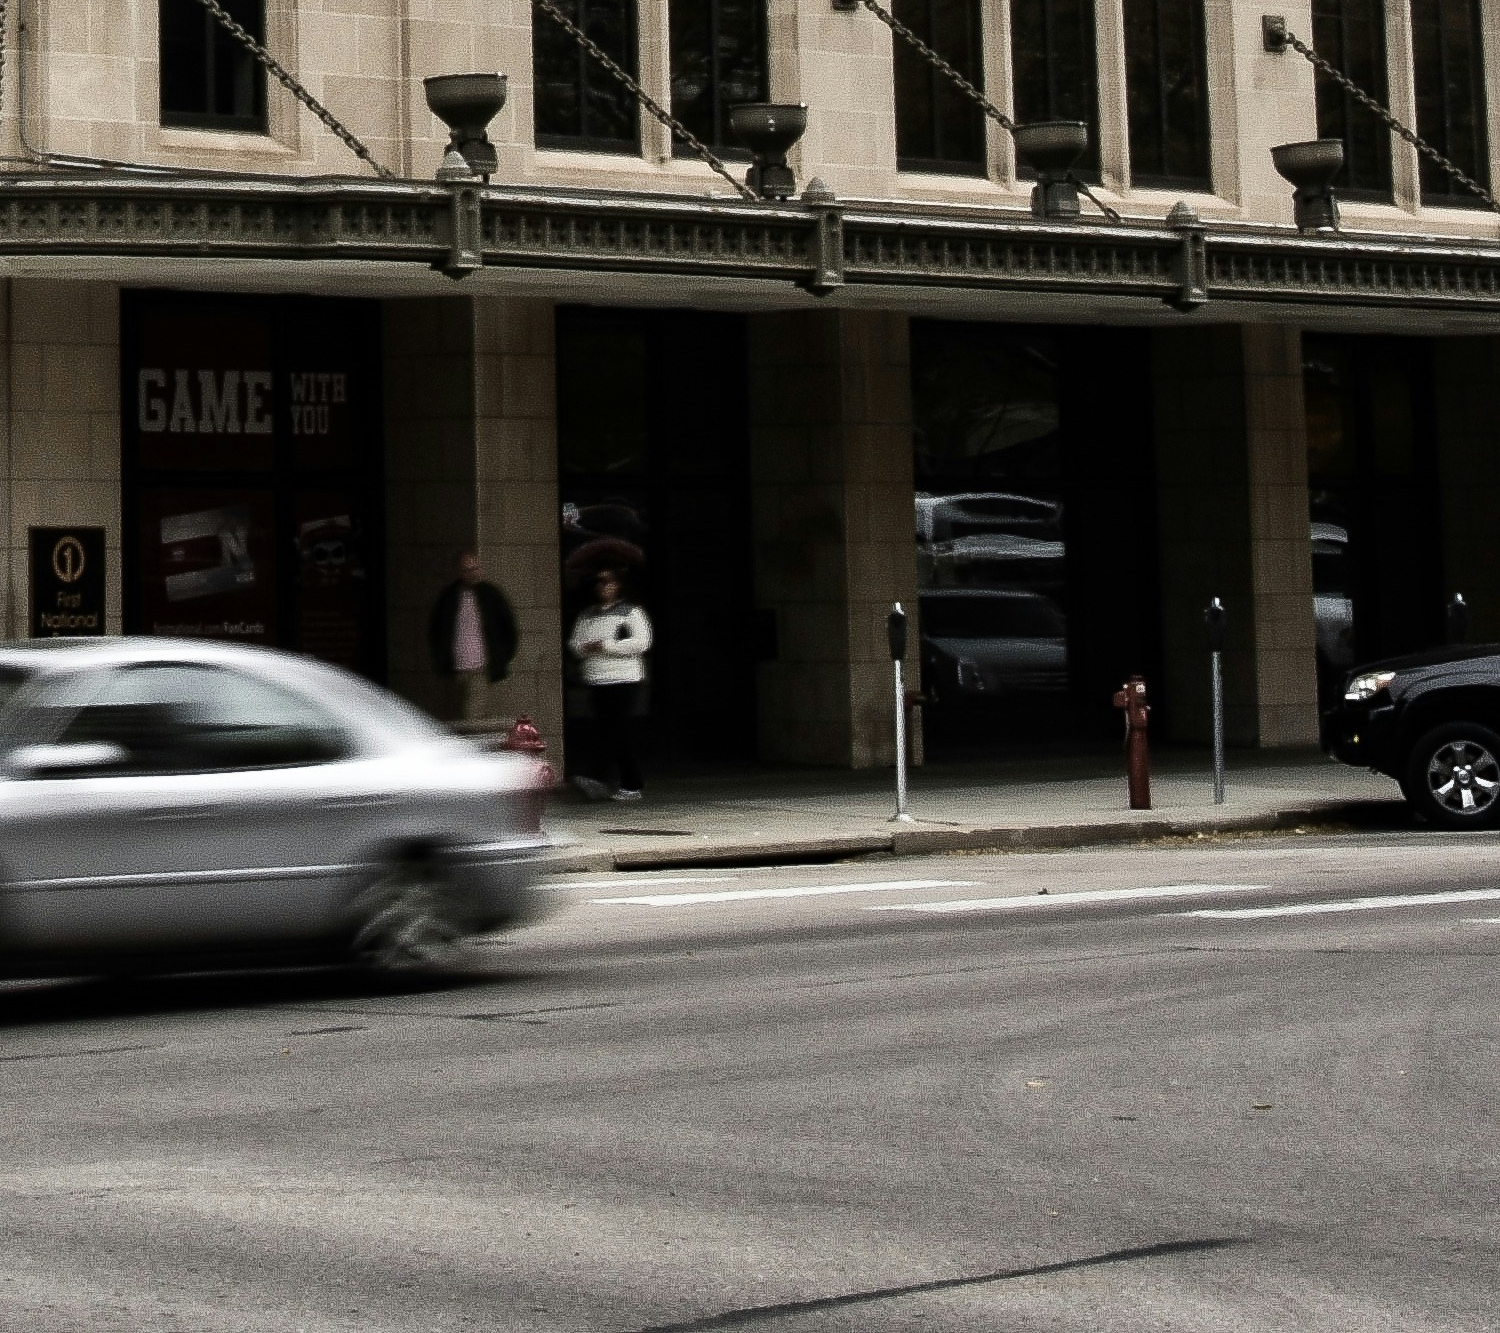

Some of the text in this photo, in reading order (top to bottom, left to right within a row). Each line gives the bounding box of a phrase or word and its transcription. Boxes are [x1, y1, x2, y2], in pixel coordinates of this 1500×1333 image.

[138, 367, 275, 435] GAME
[289, 371, 347, 404] WITH
[289, 404, 331, 436] YOU
[56, 591, 82, 608] First
[40, 611, 99, 629] National
